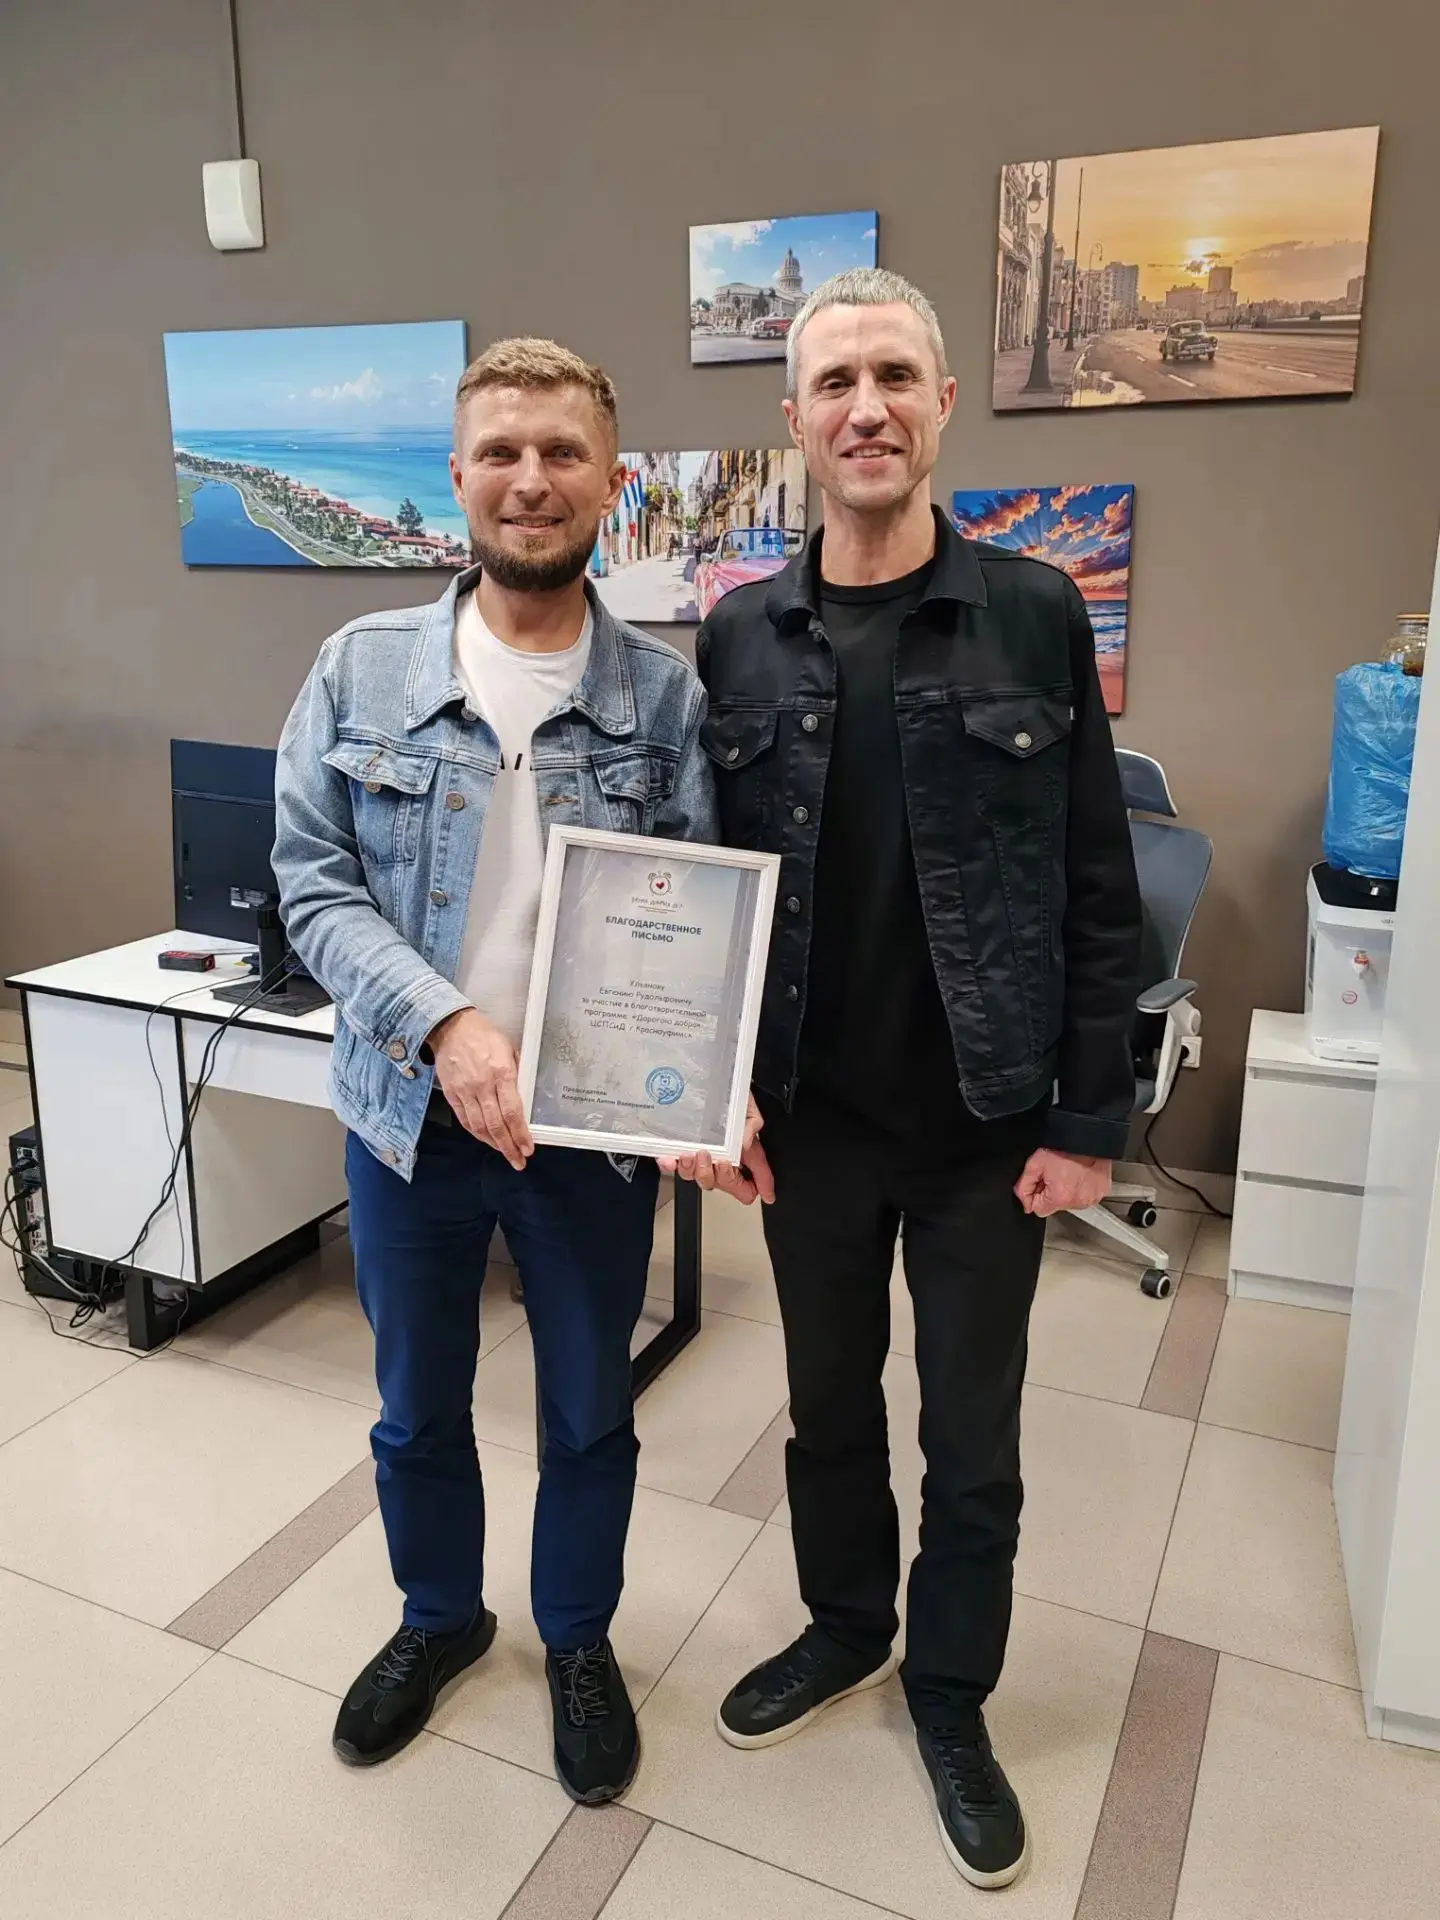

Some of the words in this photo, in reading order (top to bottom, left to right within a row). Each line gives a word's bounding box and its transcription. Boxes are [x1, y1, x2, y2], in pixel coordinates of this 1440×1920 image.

[605, 915, 702, 936] БЛАГОДАРСТВЕННОЕ
[631, 930, 674, 944] ПИСЬМО
[600, 986, 634, 998] Евгению
[591, 999, 622, 1008] участие
[630, 1002, 707, 1018] благотворительной
